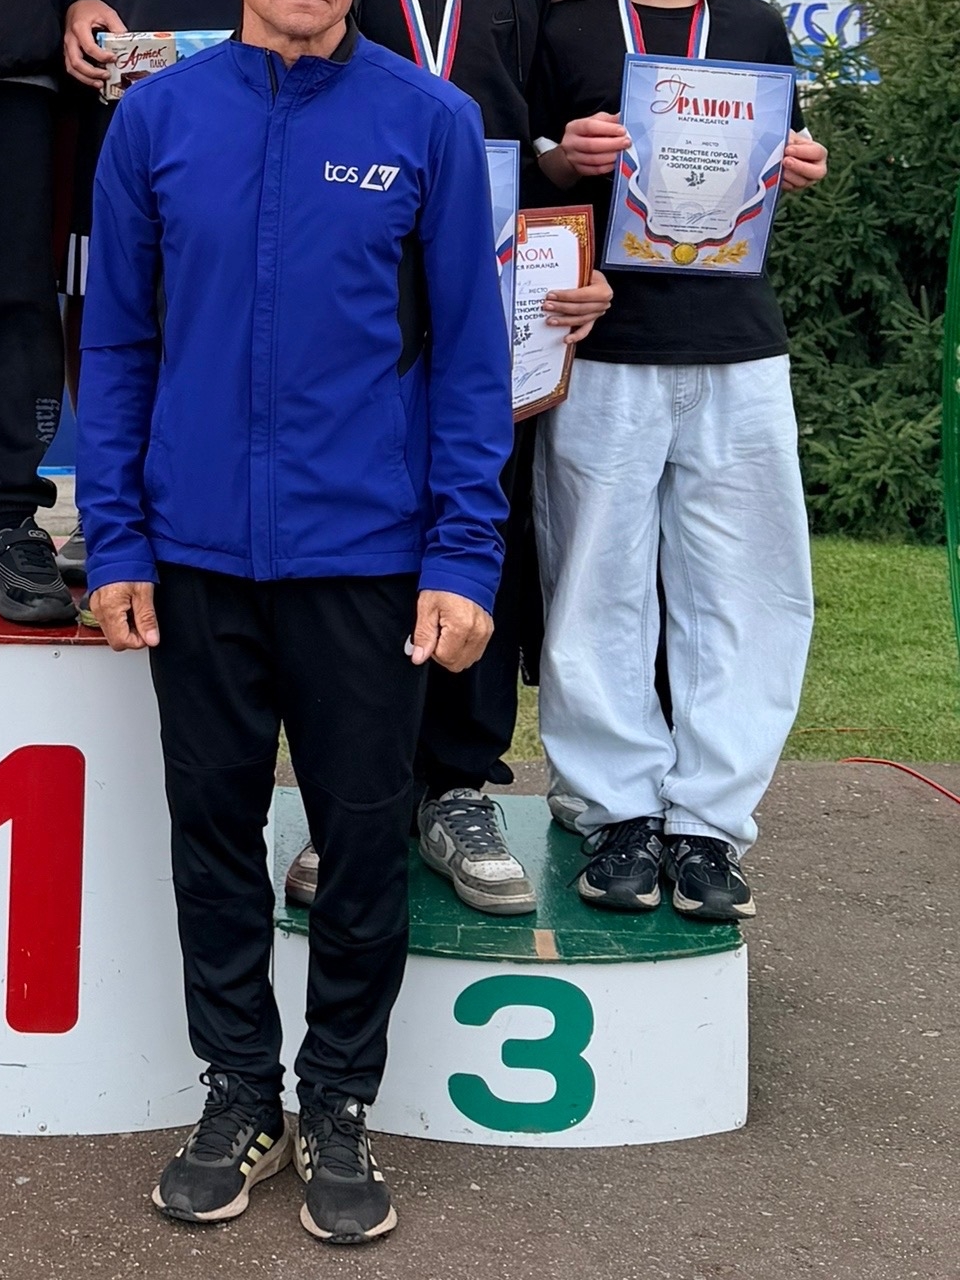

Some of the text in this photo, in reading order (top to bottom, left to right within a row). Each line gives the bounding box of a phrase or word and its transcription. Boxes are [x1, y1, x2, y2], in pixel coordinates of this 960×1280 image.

[115, 46, 167, 70] Артек
[678, 116, 729, 125] НАГРАЖДАЕТСЯ
[667, 148, 709, 157] ПЕРВЕНСТВЕ
[710, 151, 738, 159] ГОРОДА
[670, 155, 721, 165] ЭСТАФЕТНОМУ
[325, 161, 359, 183] tcs
[516, 247, 554, 262] ЛОМ
[526, 262, 559, 270] КОМАНДА
[528, 298, 545, 306] ГОРО
[448, 975, 596, 1133] 3
